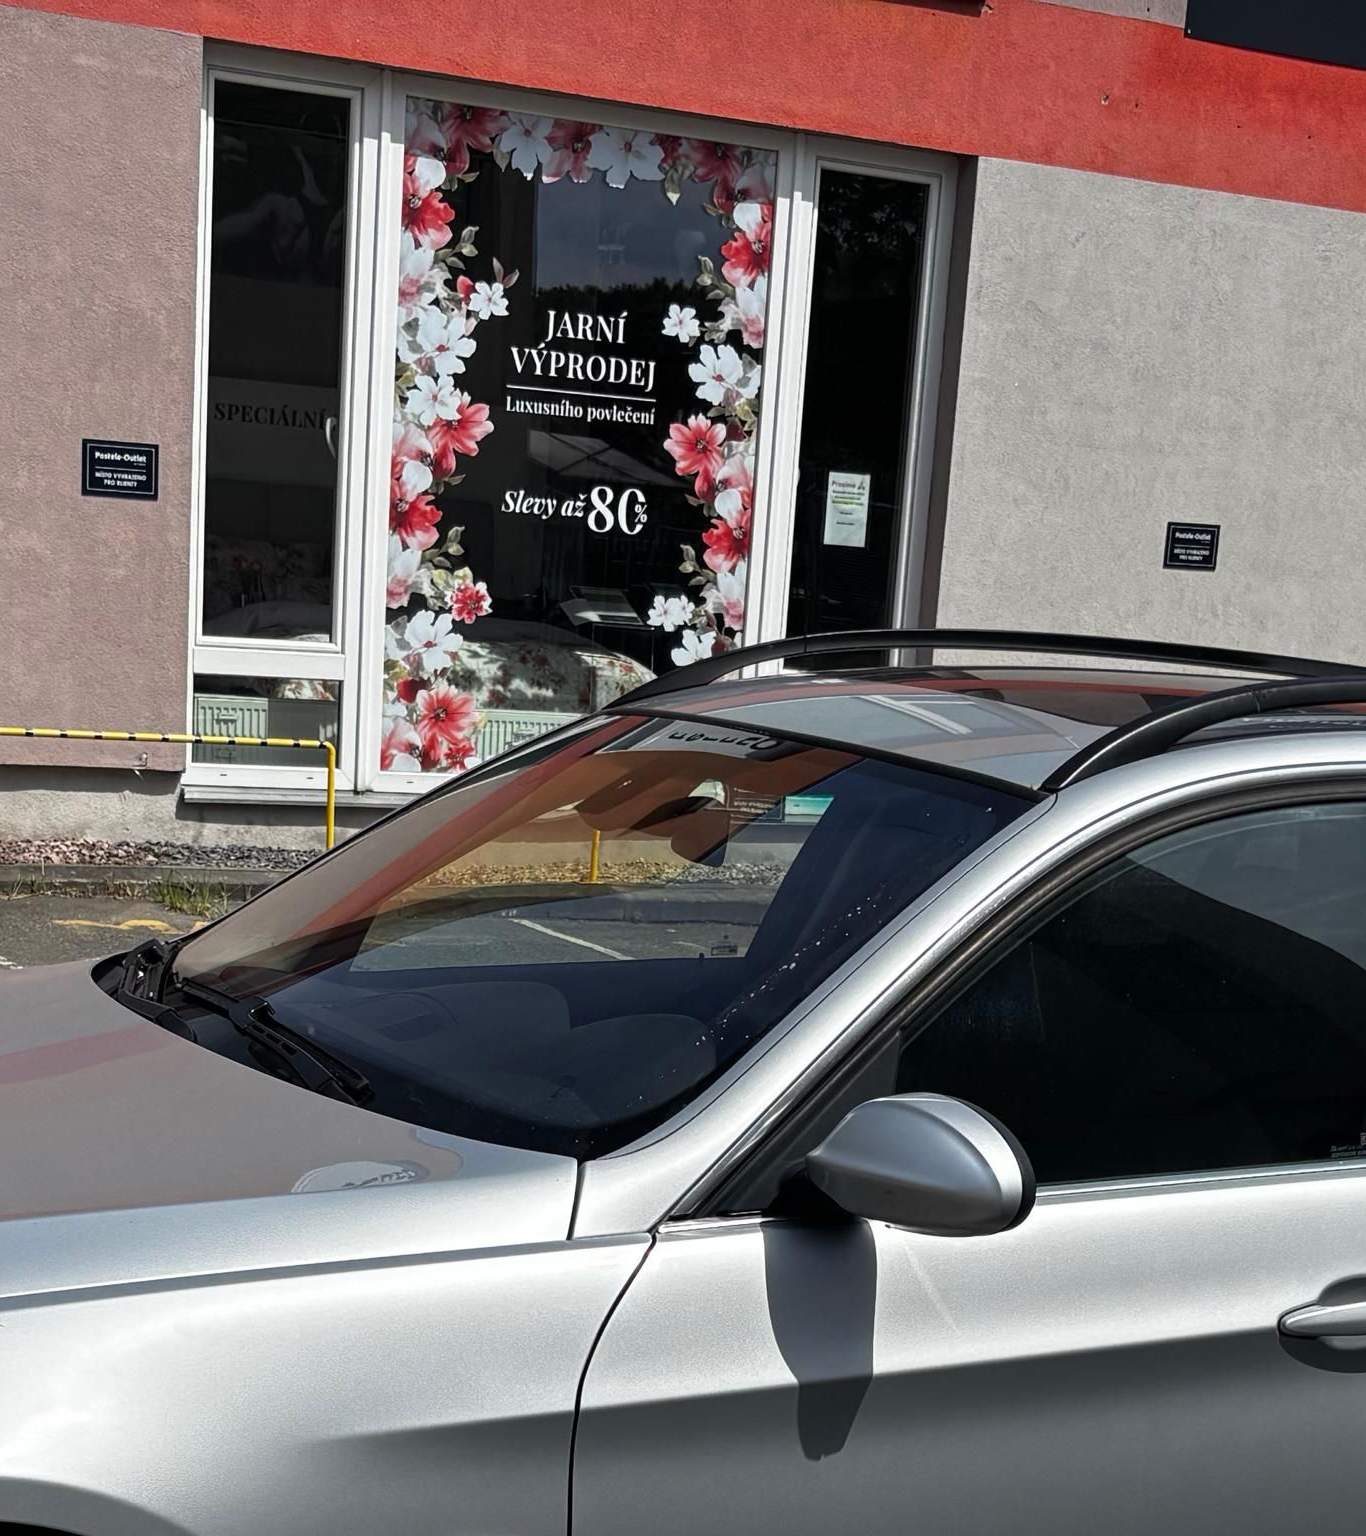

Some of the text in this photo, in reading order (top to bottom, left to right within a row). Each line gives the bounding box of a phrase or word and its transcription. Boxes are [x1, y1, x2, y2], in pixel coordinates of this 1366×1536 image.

[545, 310, 628, 344] JARNÍ
[510, 342, 656, 393] VÝPRODEJ
[214, 402, 327, 430] SPECIÁLNÍ
[506, 396, 656, 425] Luxusního povlečení
[501, 490, 557, 520] Slevy
[561, 493, 588, 518] až
